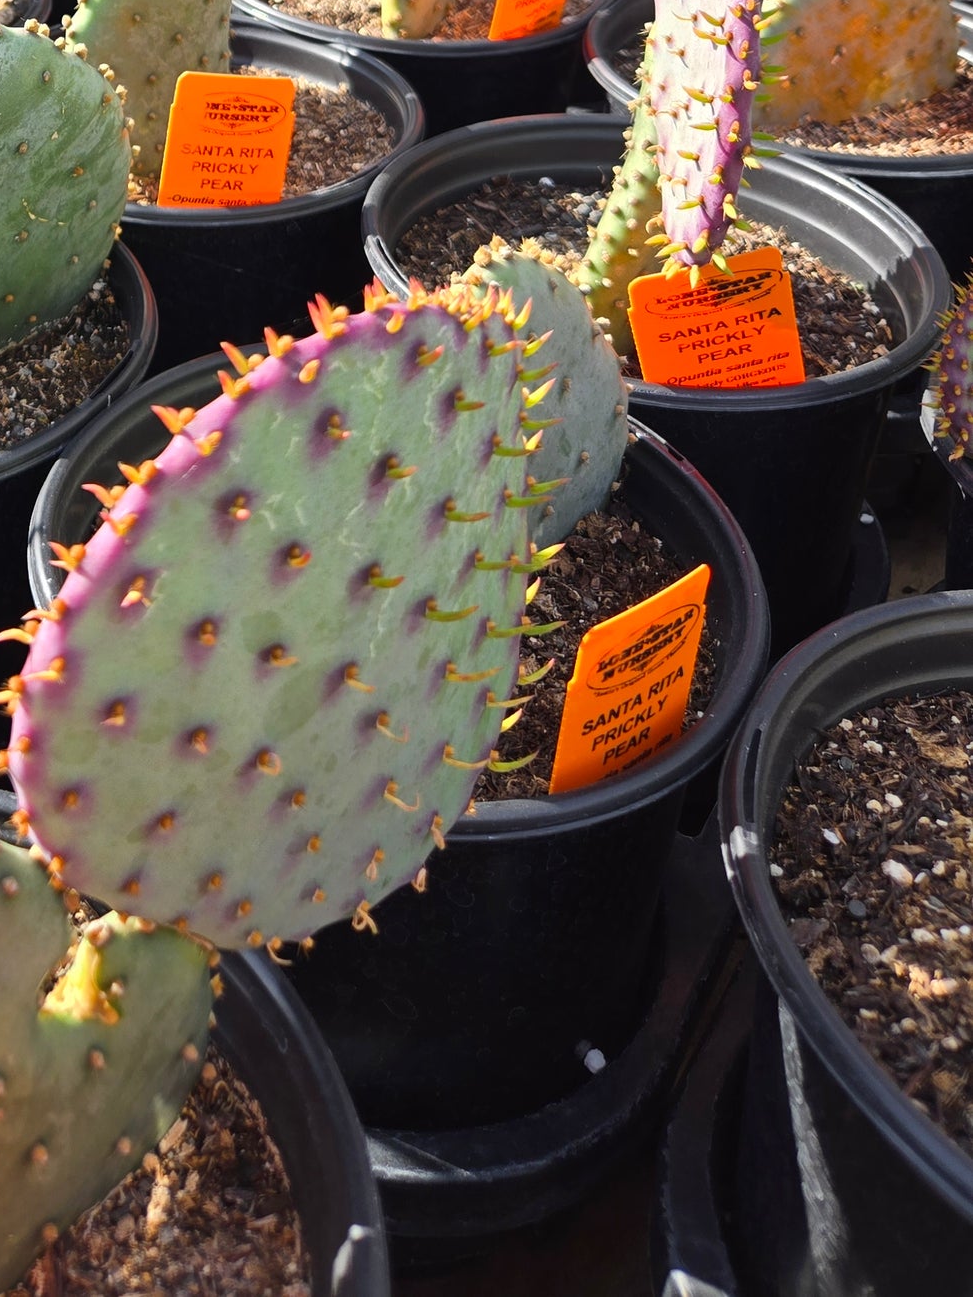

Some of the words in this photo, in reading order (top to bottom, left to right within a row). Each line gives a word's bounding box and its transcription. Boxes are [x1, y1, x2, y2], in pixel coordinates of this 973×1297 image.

[181, 143, 234, 157] SANTA
[239, 147, 274, 159] RITA
[191, 161, 259, 175] PRICKLY
[200, 178, 244, 191] PEAR
[658, 320, 729, 344] SANTA
[734, 307, 782, 326] RITA
[678, 324, 766, 354] PRICKLY
[697, 343, 753, 365] PEAR
[726, 357, 763, 371] santa
[767, 351, 790, 363] rita
[581, 693, 642, 736] SANTA
[648, 665, 684, 700] RITA
[591, 694, 668, 752] PRICKLY
[603, 725, 651, 766] PEAR
